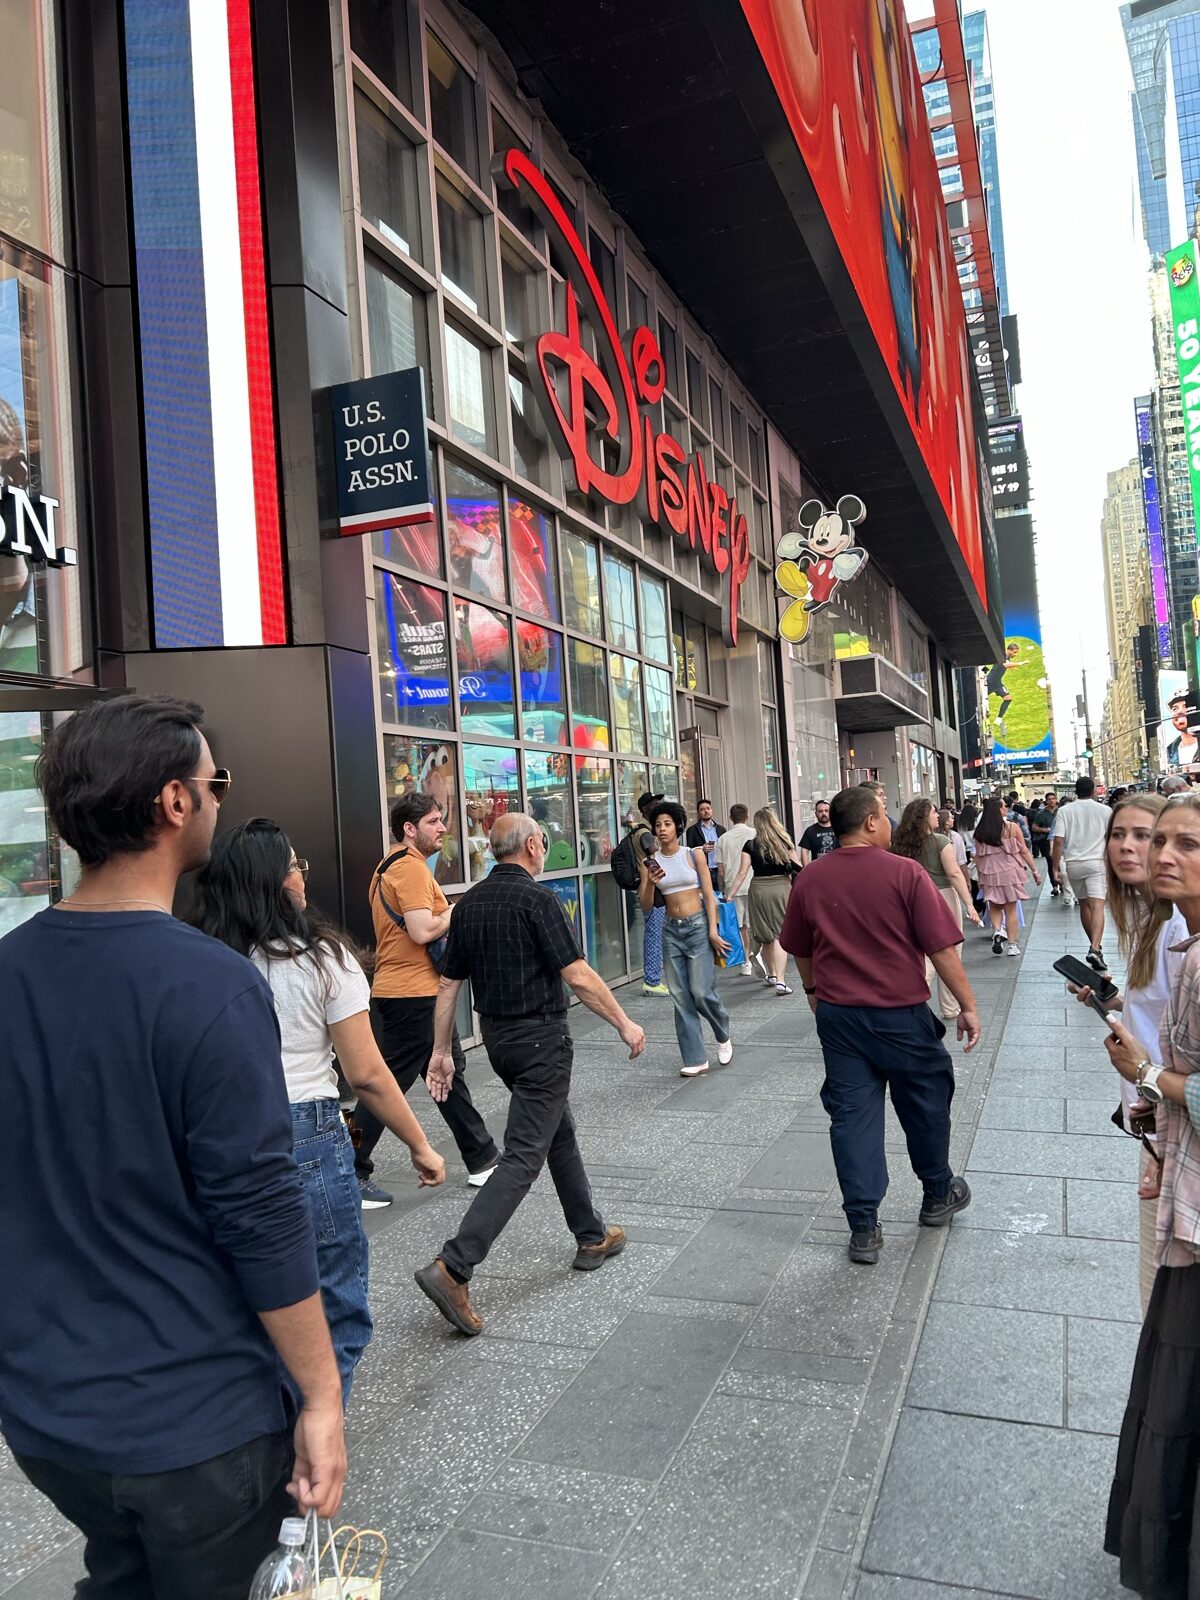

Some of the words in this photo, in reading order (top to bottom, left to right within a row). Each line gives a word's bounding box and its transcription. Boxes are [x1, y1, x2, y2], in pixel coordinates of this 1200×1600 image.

[1177, 318, 1200, 361] 50
[498, 147, 750, 648] Disney
[342, 401, 386, 427] U.S.
[344, 429, 410, 461] POLO
[347, 460, 418, 492] ASSN.
[991, 464, 1006, 476] NE
[993, 483, 1006, 495] LY
[0, 477, 77, 564] N.
